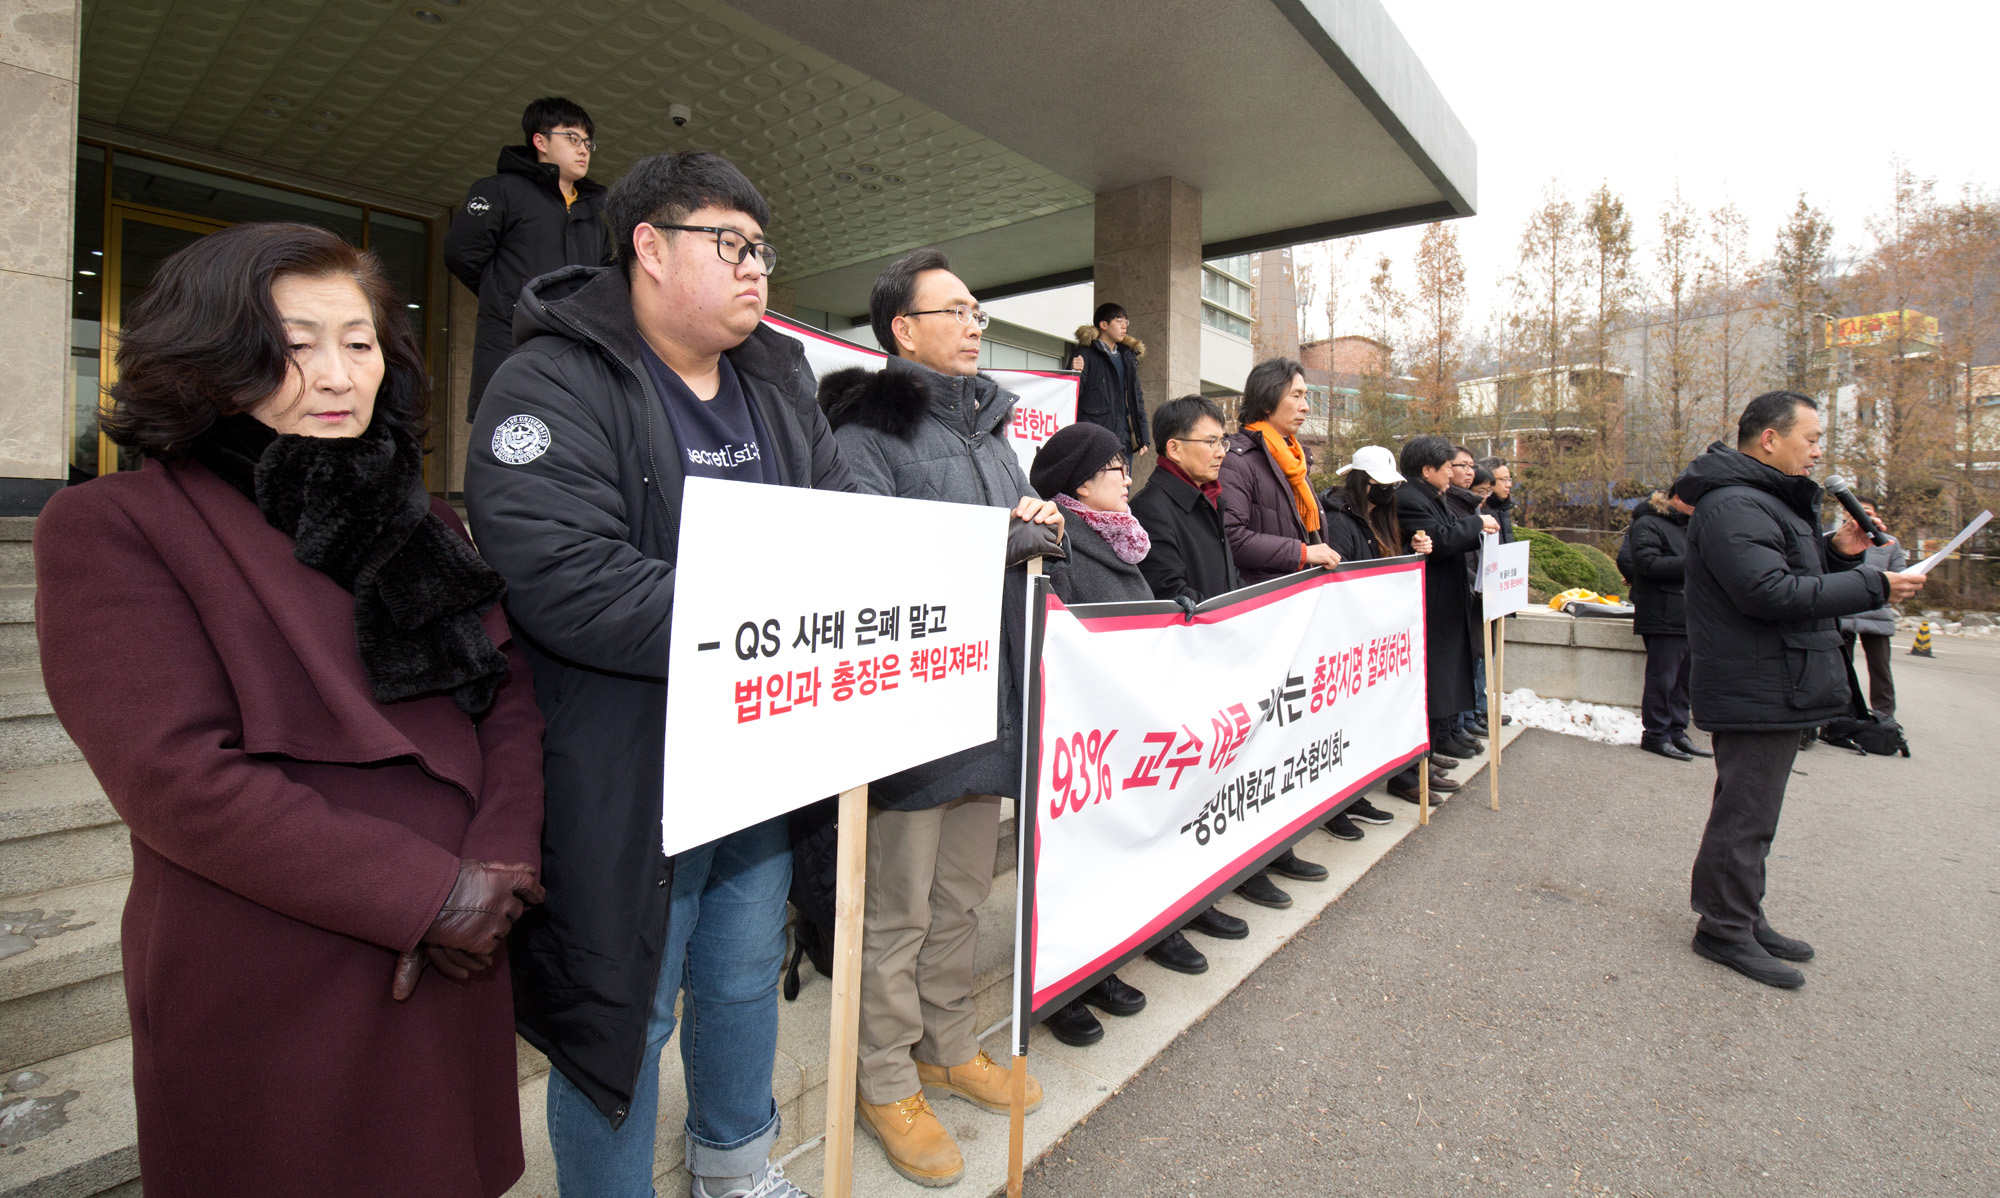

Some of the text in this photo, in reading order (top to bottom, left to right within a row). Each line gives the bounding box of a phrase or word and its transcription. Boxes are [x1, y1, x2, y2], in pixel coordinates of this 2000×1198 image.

[735, 619, 781, 661] QS
[792, 611, 845, 654] 사태
[855, 606, 900, 646] 은폐
[909, 604, 947, 639] 말고
[734, 640, 989, 725] 법인과 총장은 책임져라!
[1050, 728, 1119, 820] 93%
[1122, 724, 1205, 791] 교수
[1310, 643, 1364, 714] 총장지명
[1367, 628, 1412, 688] 철회하라
[1280, 728, 1350, 795] 교수협의회-
